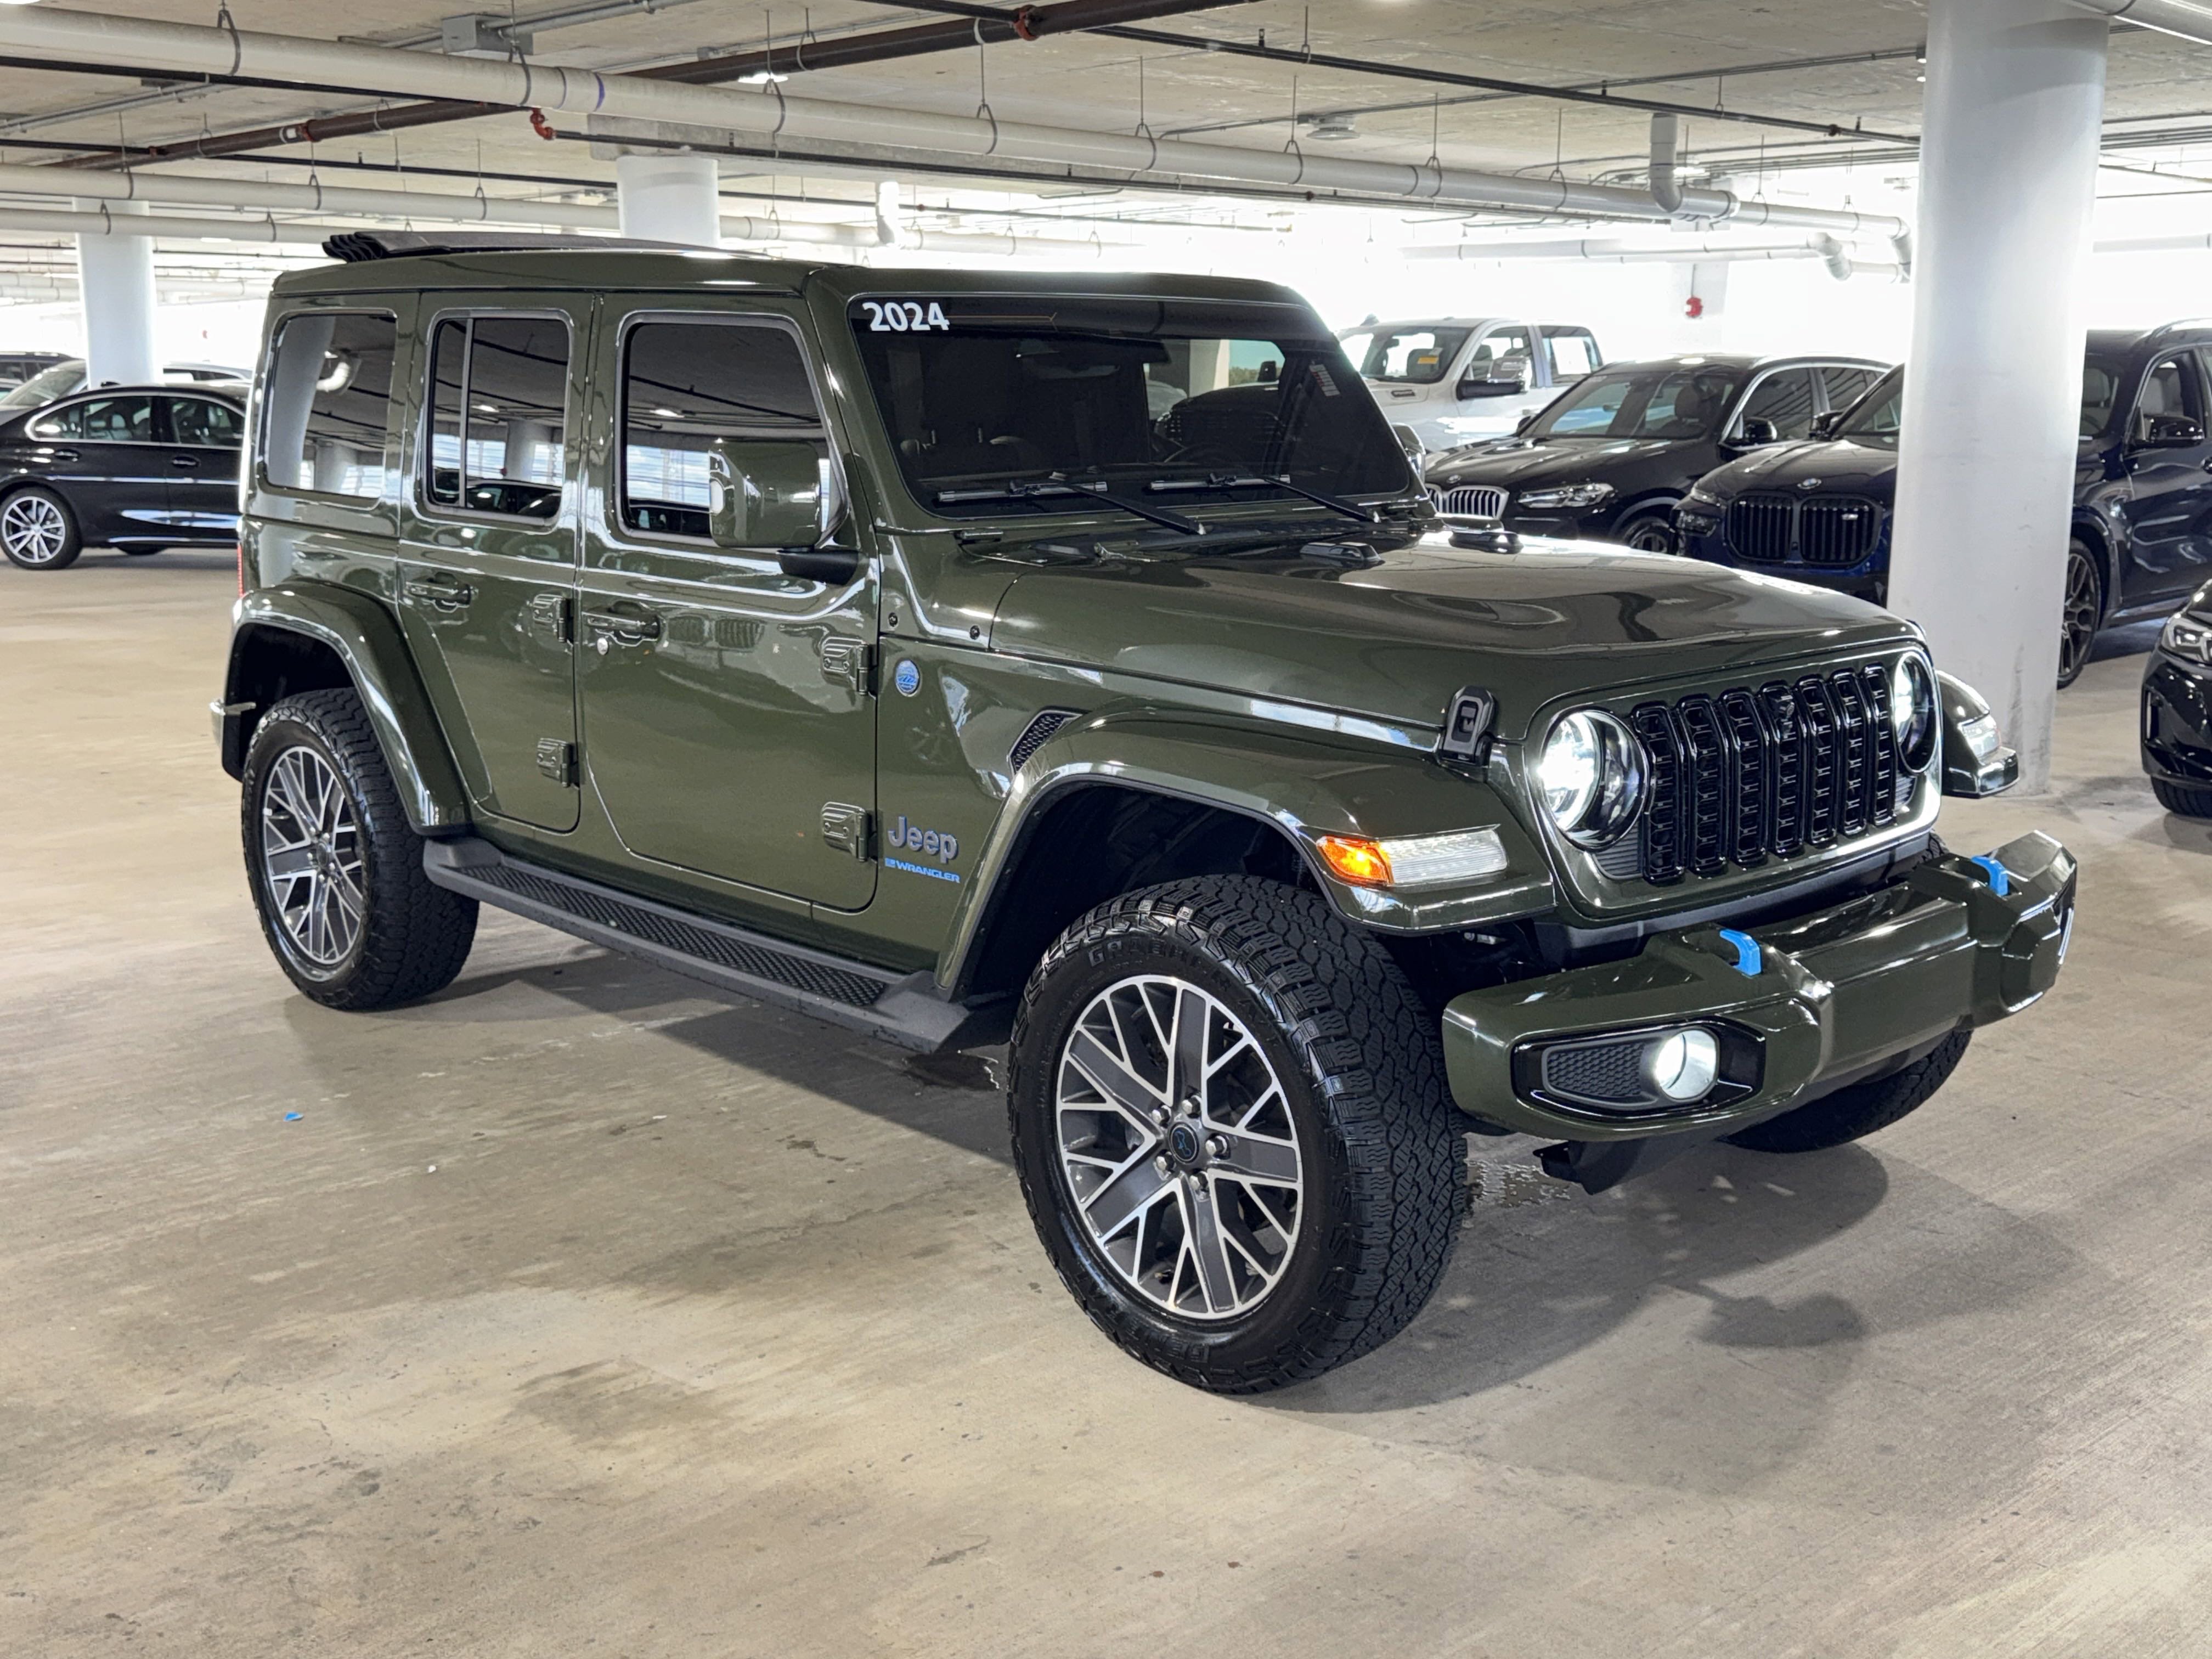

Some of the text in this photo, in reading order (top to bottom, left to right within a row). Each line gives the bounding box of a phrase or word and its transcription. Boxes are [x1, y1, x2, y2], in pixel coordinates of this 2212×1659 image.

[862, 302, 950, 331] 2024
[888, 816, 958, 864] Jeep
[896, 860, 960, 883] WRANGLER
